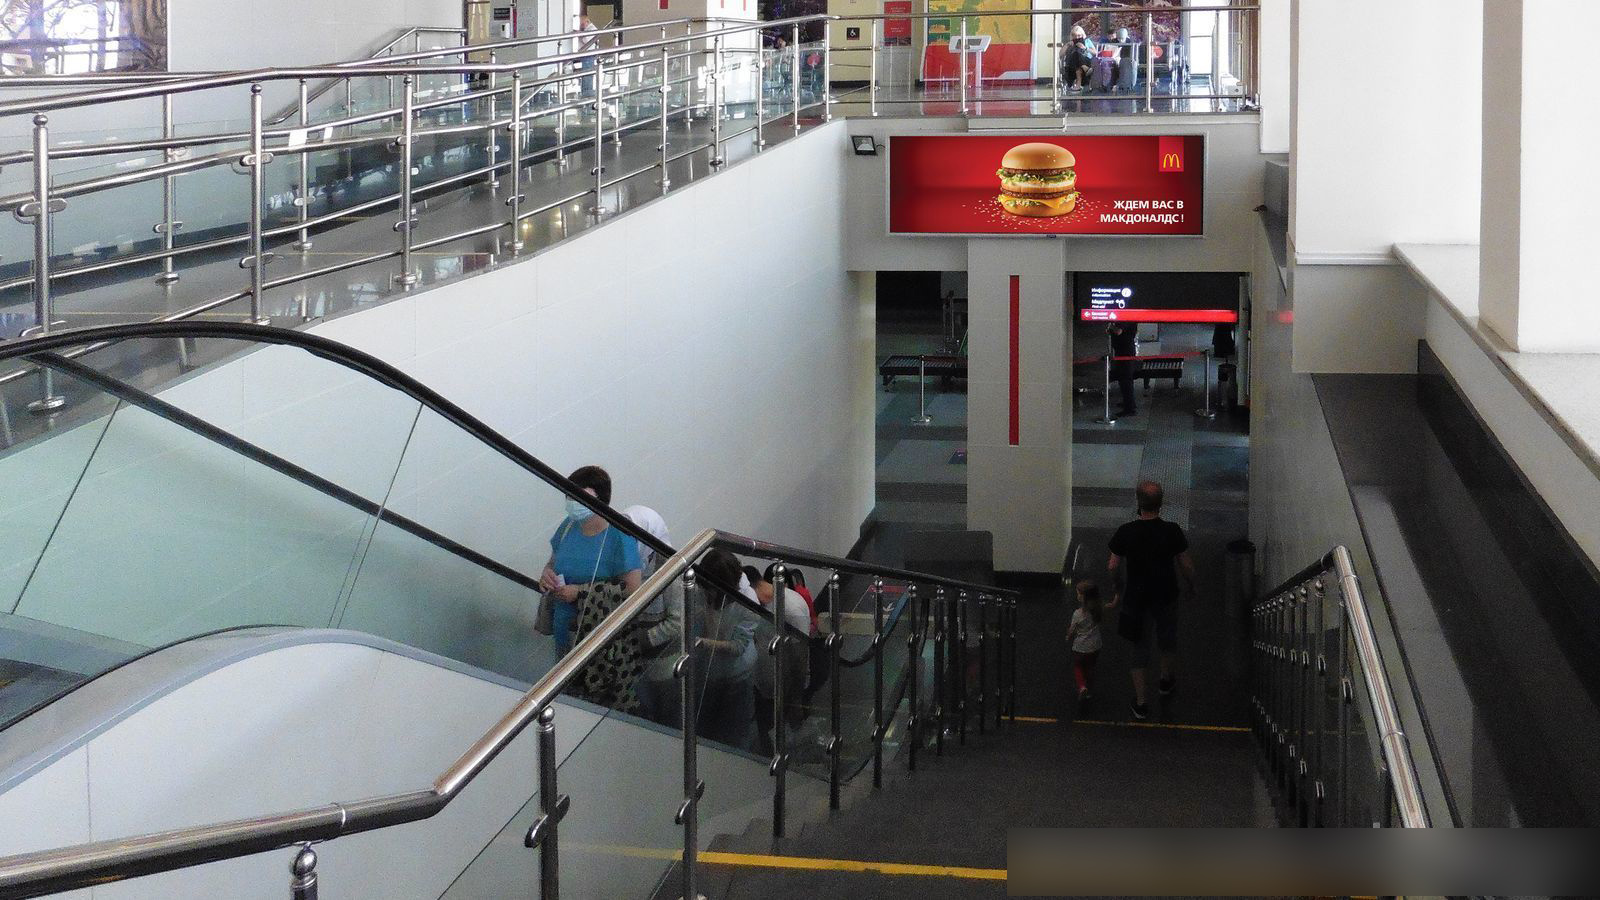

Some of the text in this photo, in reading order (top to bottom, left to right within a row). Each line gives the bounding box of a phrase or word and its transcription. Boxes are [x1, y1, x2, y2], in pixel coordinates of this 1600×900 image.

[1113, 200, 1184, 210] ЖДЕМ ВАС В
